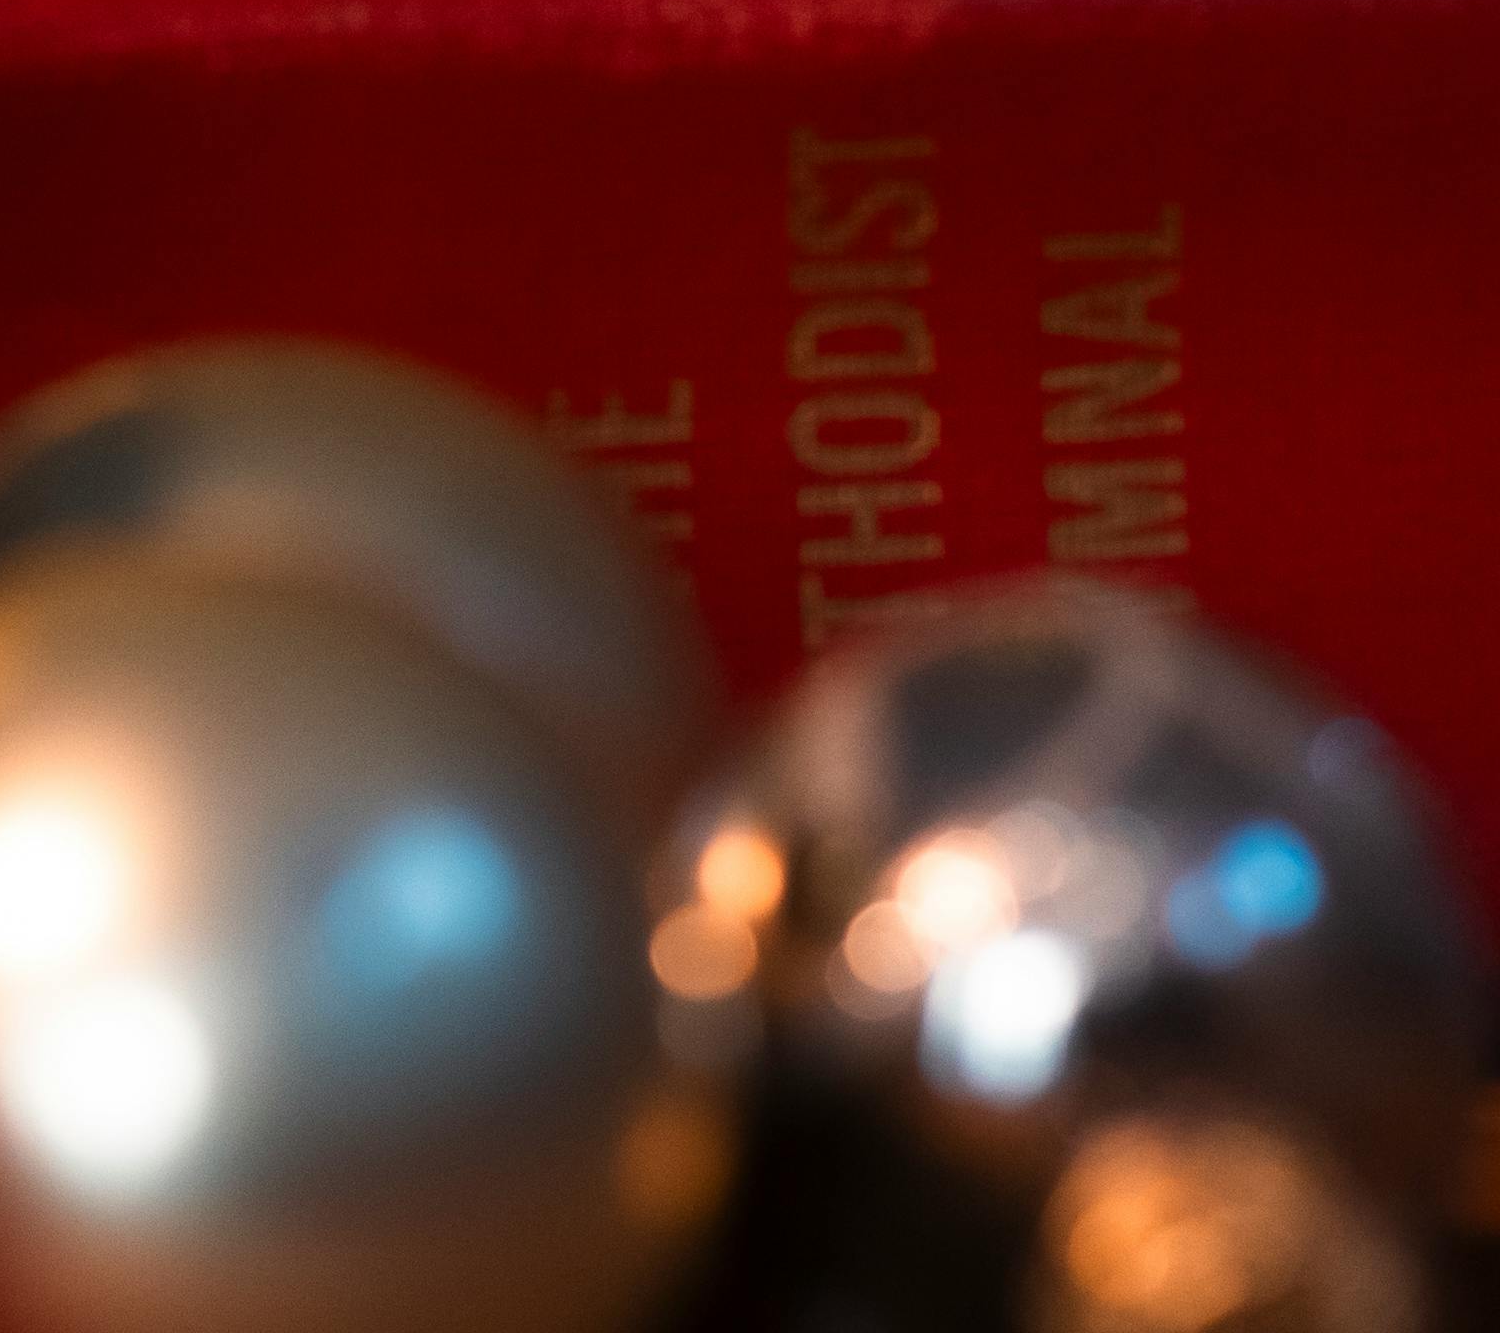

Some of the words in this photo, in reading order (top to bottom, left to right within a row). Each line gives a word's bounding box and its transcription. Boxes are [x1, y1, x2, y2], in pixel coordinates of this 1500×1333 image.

[546, 377, 694, 547] HE
[786, 128, 946, 651] THODIST
[1040, 201, 1192, 567] MNAL
